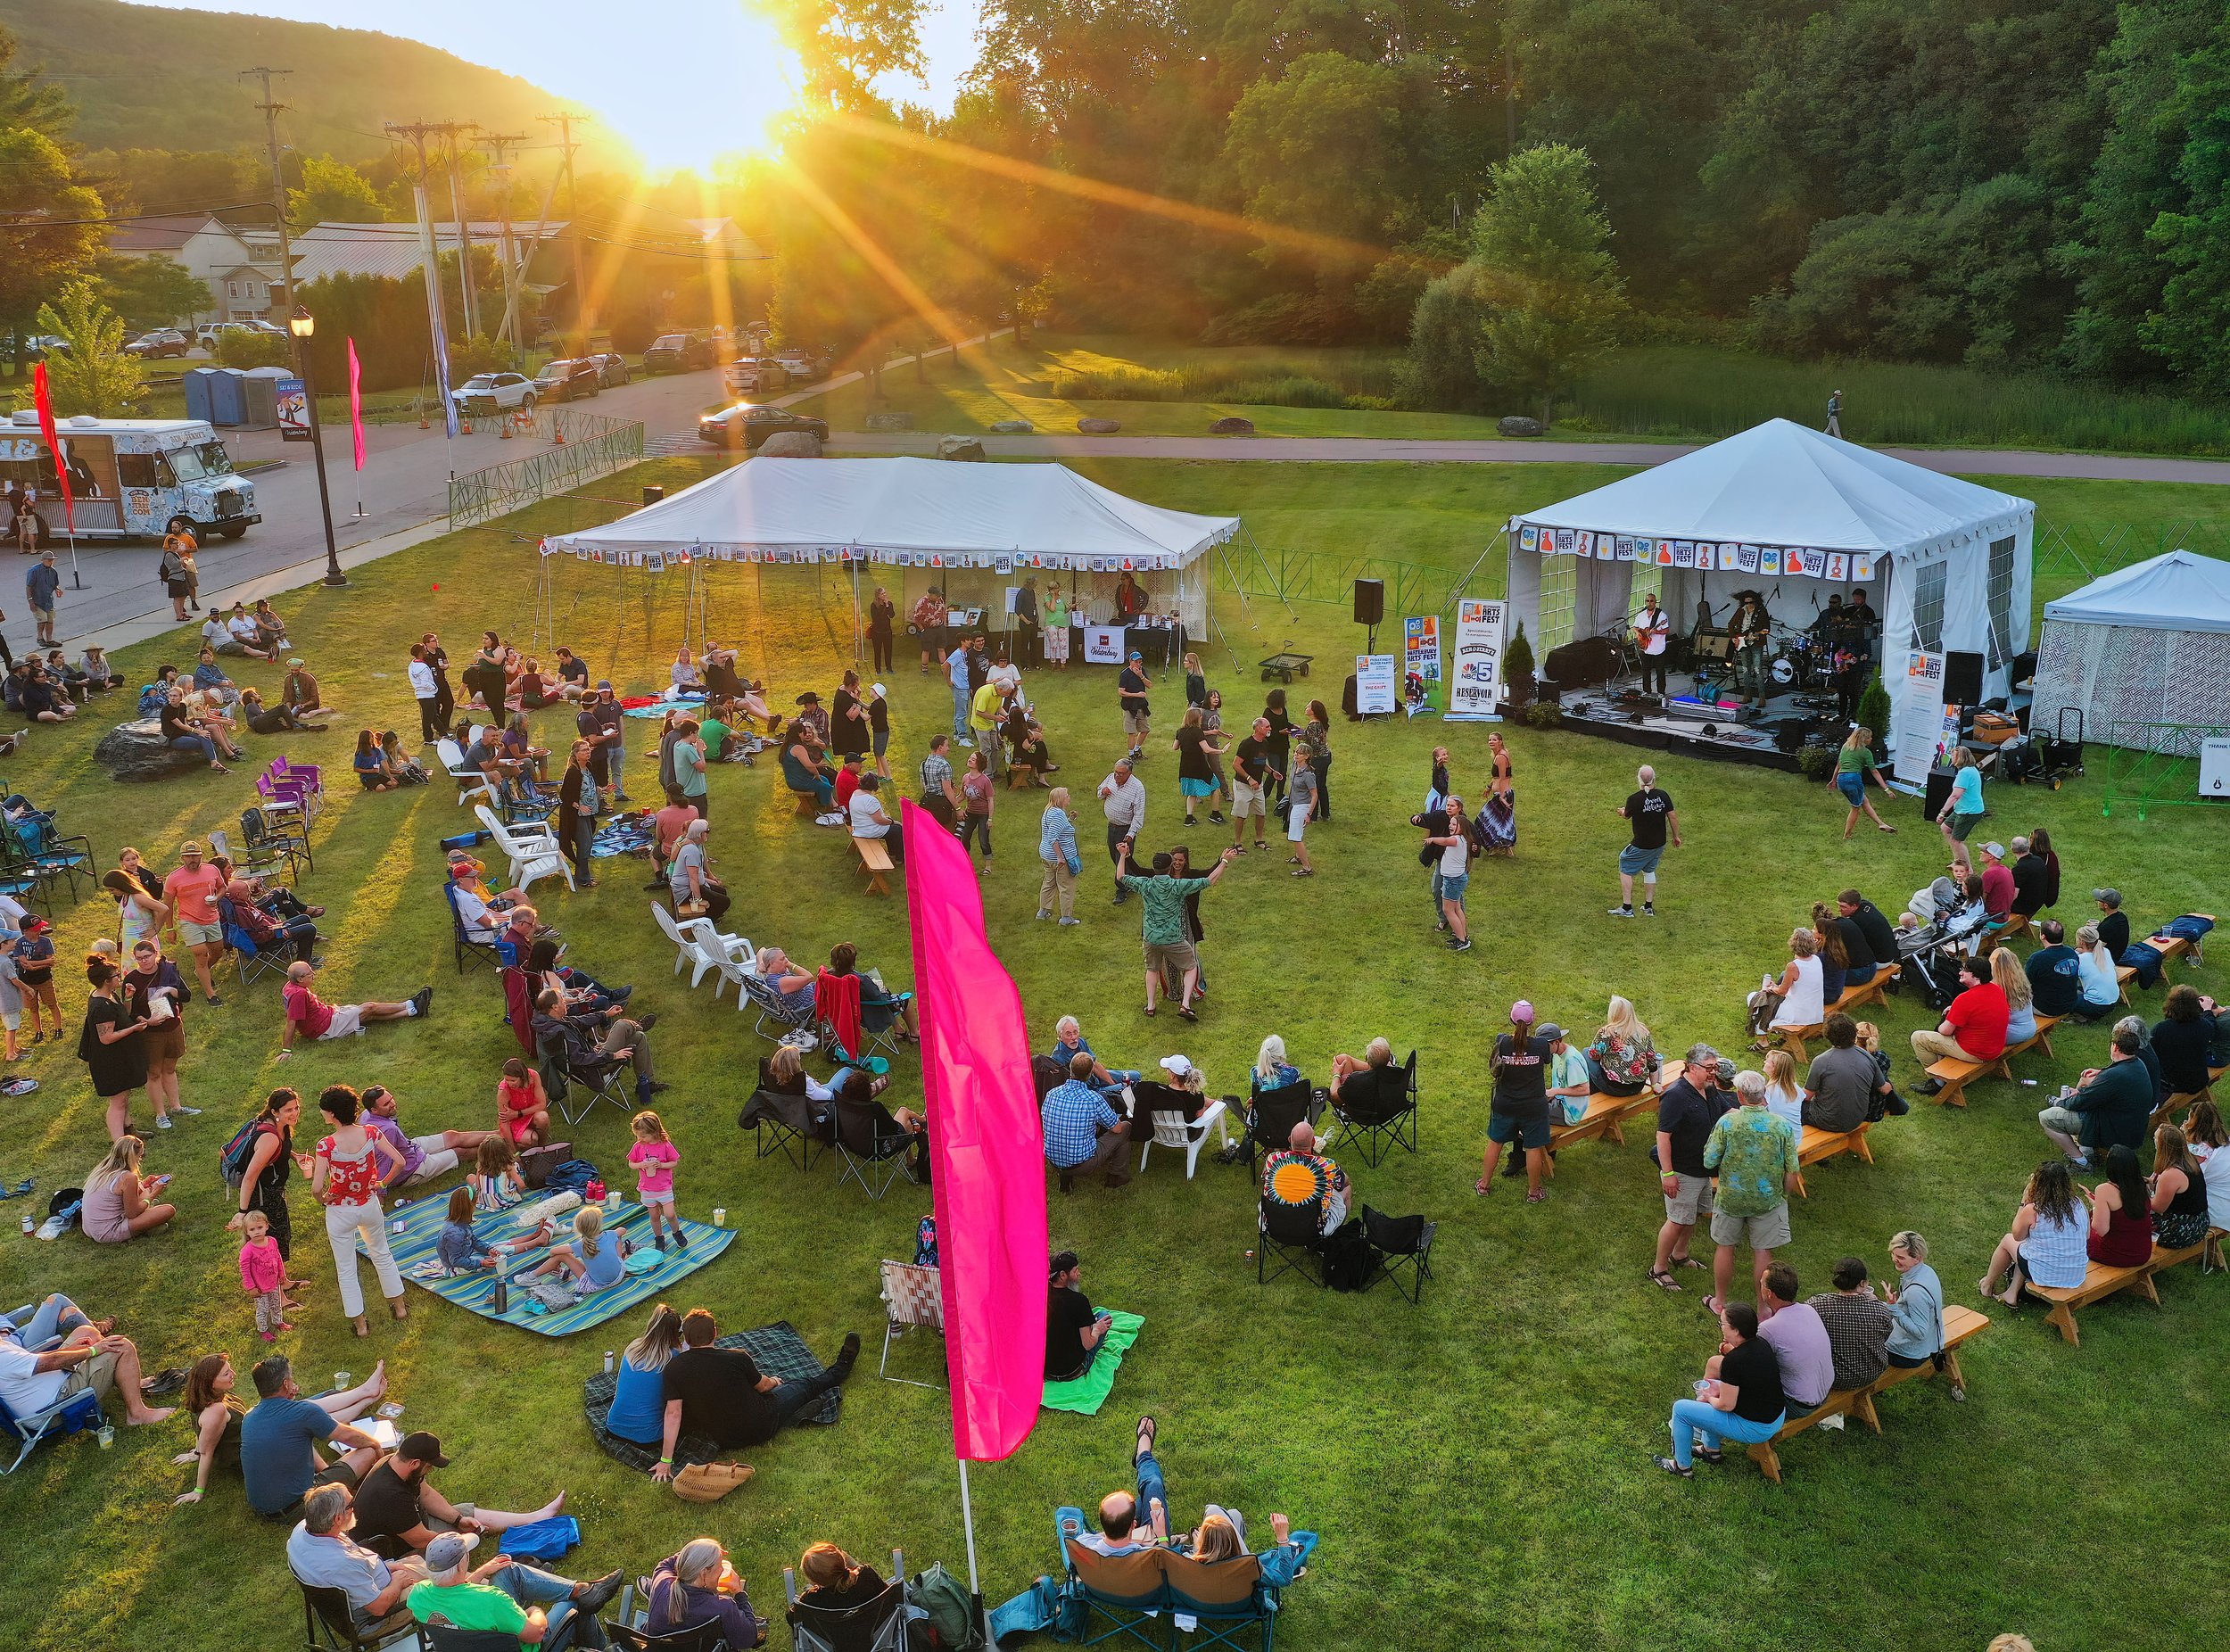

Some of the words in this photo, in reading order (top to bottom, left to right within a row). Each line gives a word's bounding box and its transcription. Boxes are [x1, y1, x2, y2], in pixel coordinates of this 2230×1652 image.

[1739, 551, 1755, 560] ARTS
[1739, 558, 1755, 567] FEST
[1805, 557, 1821, 566] ARTS
[1804, 563, 1821, 573] FEST
[1483, 608, 1500, 616] ARTS
[1482, 615, 1500, 624] FEST
[1926, 662, 1941, 671] ARTS
[1479, 663, 1491, 681] 5
[1925, 670, 1940, 680] FEST
[1457, 688, 1492, 698] RESERVOIR
